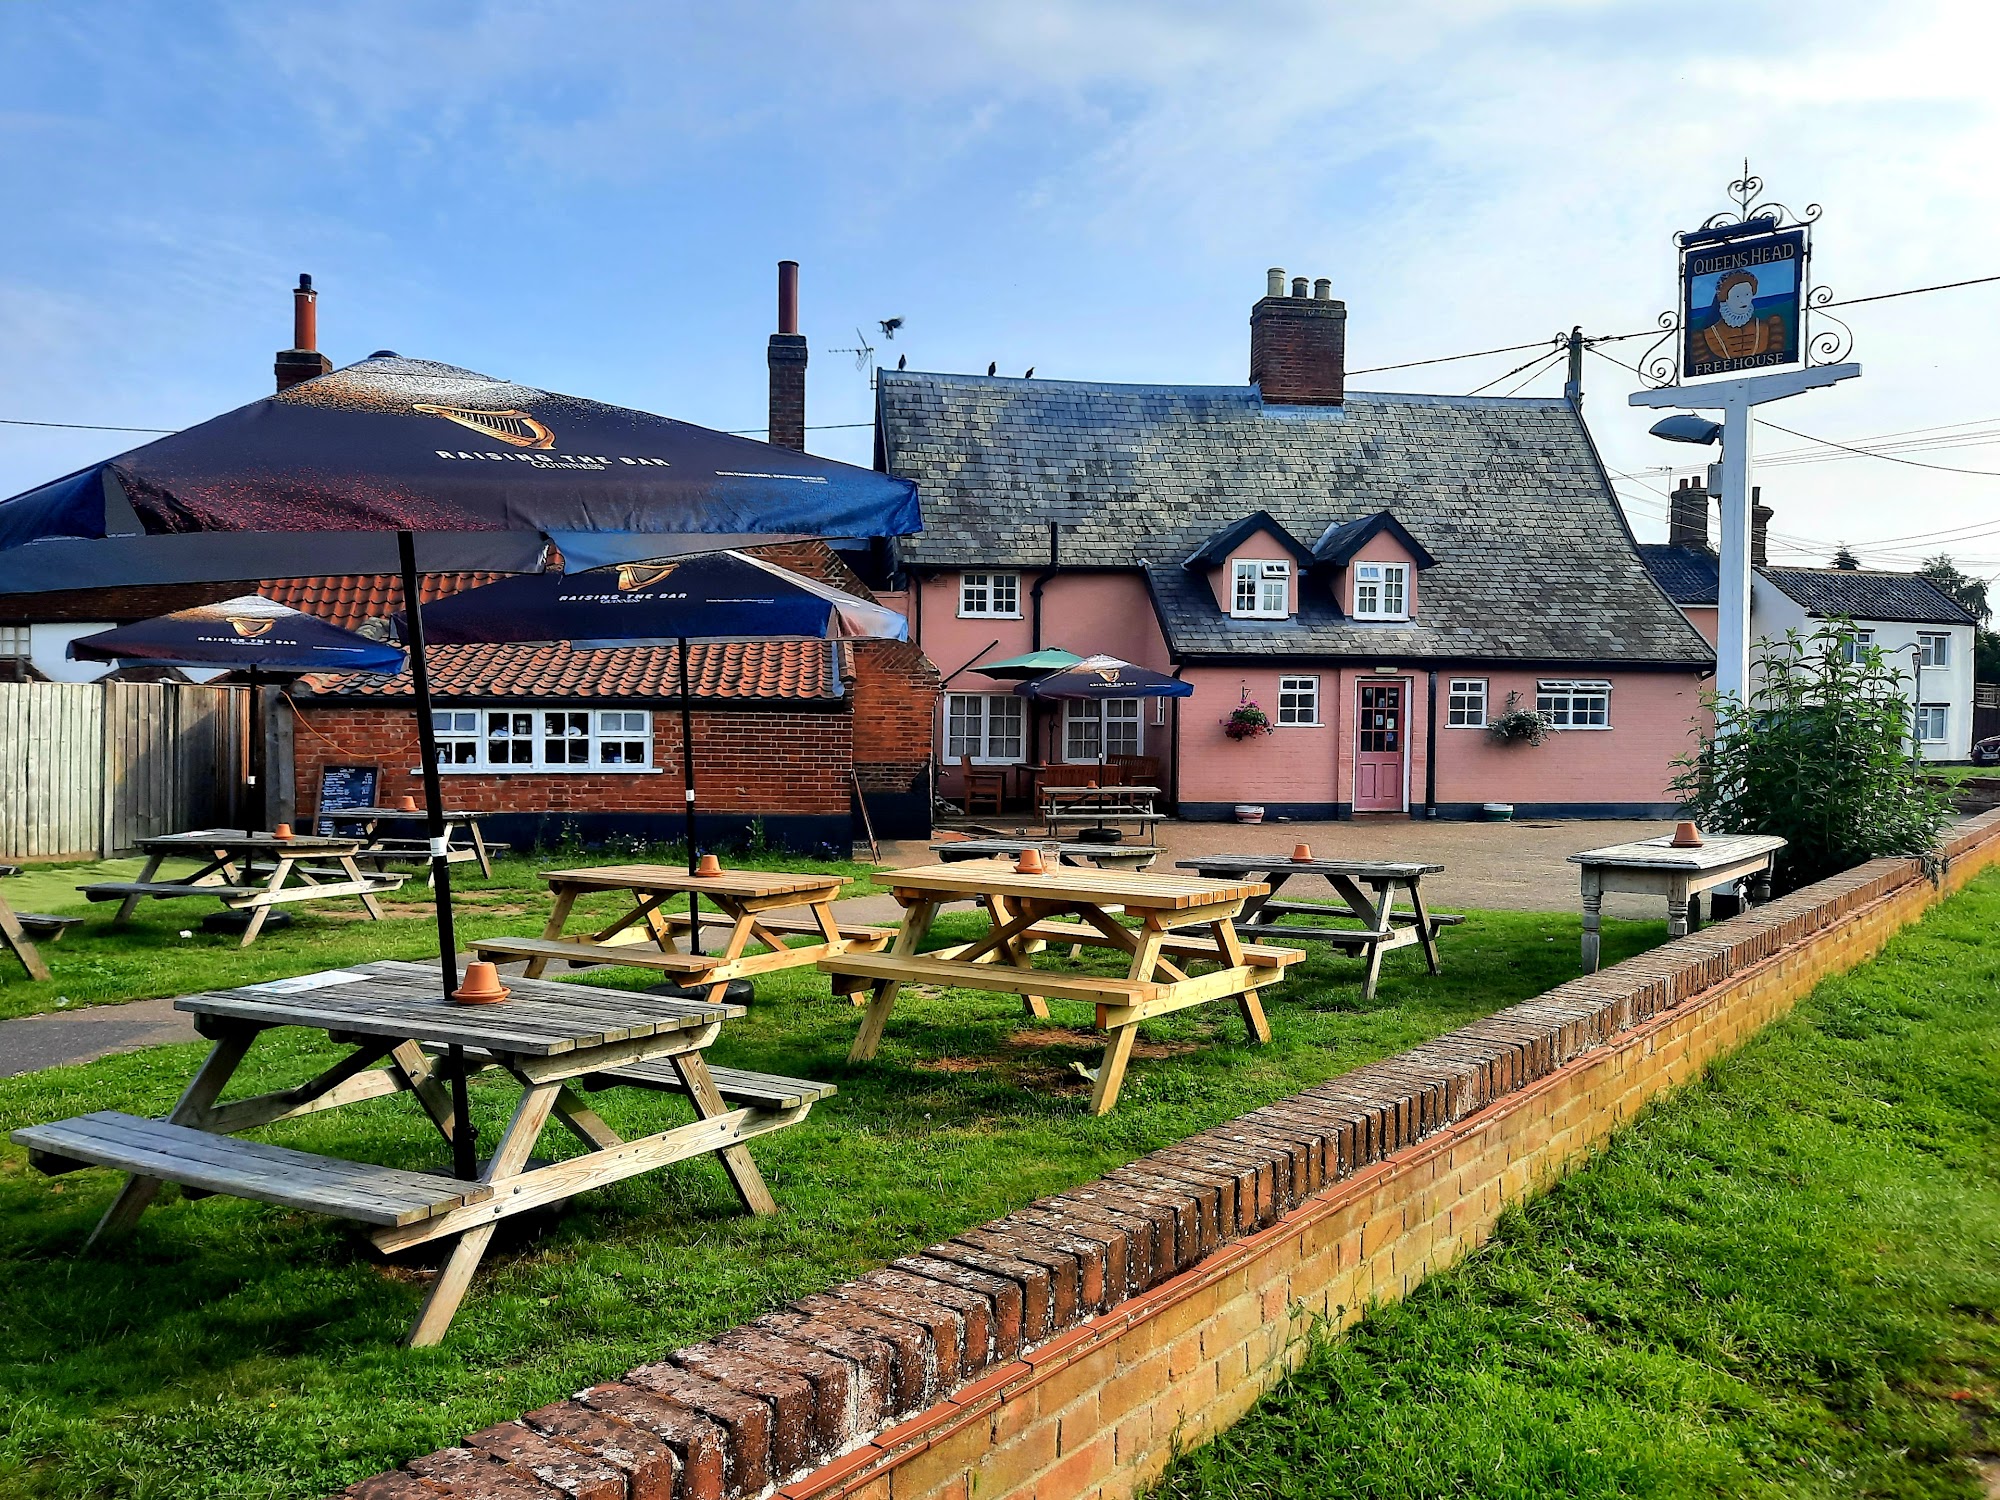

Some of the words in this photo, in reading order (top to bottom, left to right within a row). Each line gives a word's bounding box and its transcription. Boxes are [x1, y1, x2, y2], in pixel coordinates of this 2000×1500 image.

[1694, 252, 1749, 275] QUEENS
[1751, 243, 1794, 264] HEAD
[1695, 358, 1732, 375] FREE
[1734, 353, 1784, 369] HOUSE
[435, 450, 553, 462] RAISING
[561, 455, 613, 465] THE
[619, 457, 671, 467] BAR
[530, 460, 606, 471] GUINNESS
